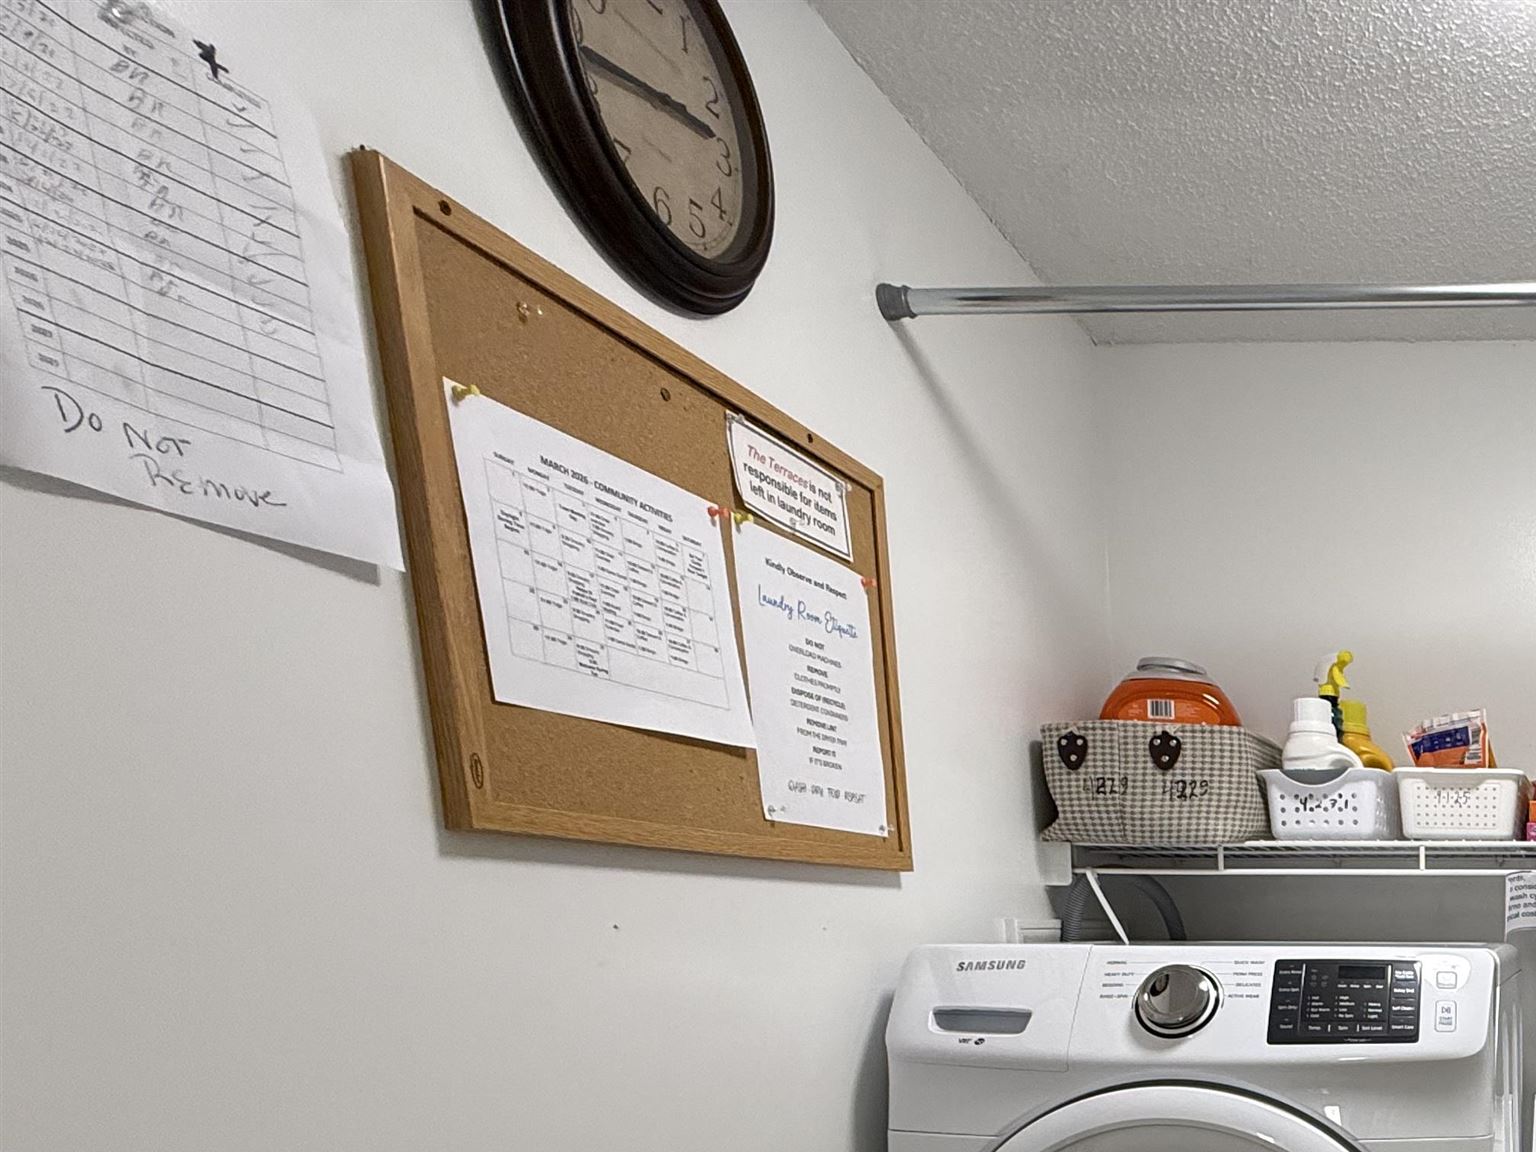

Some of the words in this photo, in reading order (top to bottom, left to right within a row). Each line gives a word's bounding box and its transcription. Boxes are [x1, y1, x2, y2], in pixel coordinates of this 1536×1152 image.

[703, 75, 721, 120] 2
[716, 137, 732, 178] 3
[652, 186, 672, 227] 6
[689, 197, 707, 239] 5
[710, 186, 728, 223] 4
[540, 455, 569, 477] MARCH
[594, 480, 638, 507] COMMUNITY
[639, 501, 673, 523] ACTIVITIES
[743, 462, 798, 500] responsible
[799, 491, 812, 507] for
[814, 499, 837, 521] items
[747, 444, 766, 465] The
[769, 456, 808, 490] Terraces
[809, 480, 816, 495] is
[818, 488, 832, 504] not
[749, 480, 766, 500] left
[767, 489, 776, 505] in
[777, 495, 812, 526] laundry
[813, 517, 836, 537] room
[765, 557, 786, 575] Kindly
[787, 566, 812, 585] Observe
[813, 580, 825, 590] and
[758, 583, 794, 621] Laundry
[797, 599, 822, 624] Room
[805, 637, 814, 647] DO
[814, 641, 825, 651] NOT
[956, 958, 1027, 973] SAMSUNG
